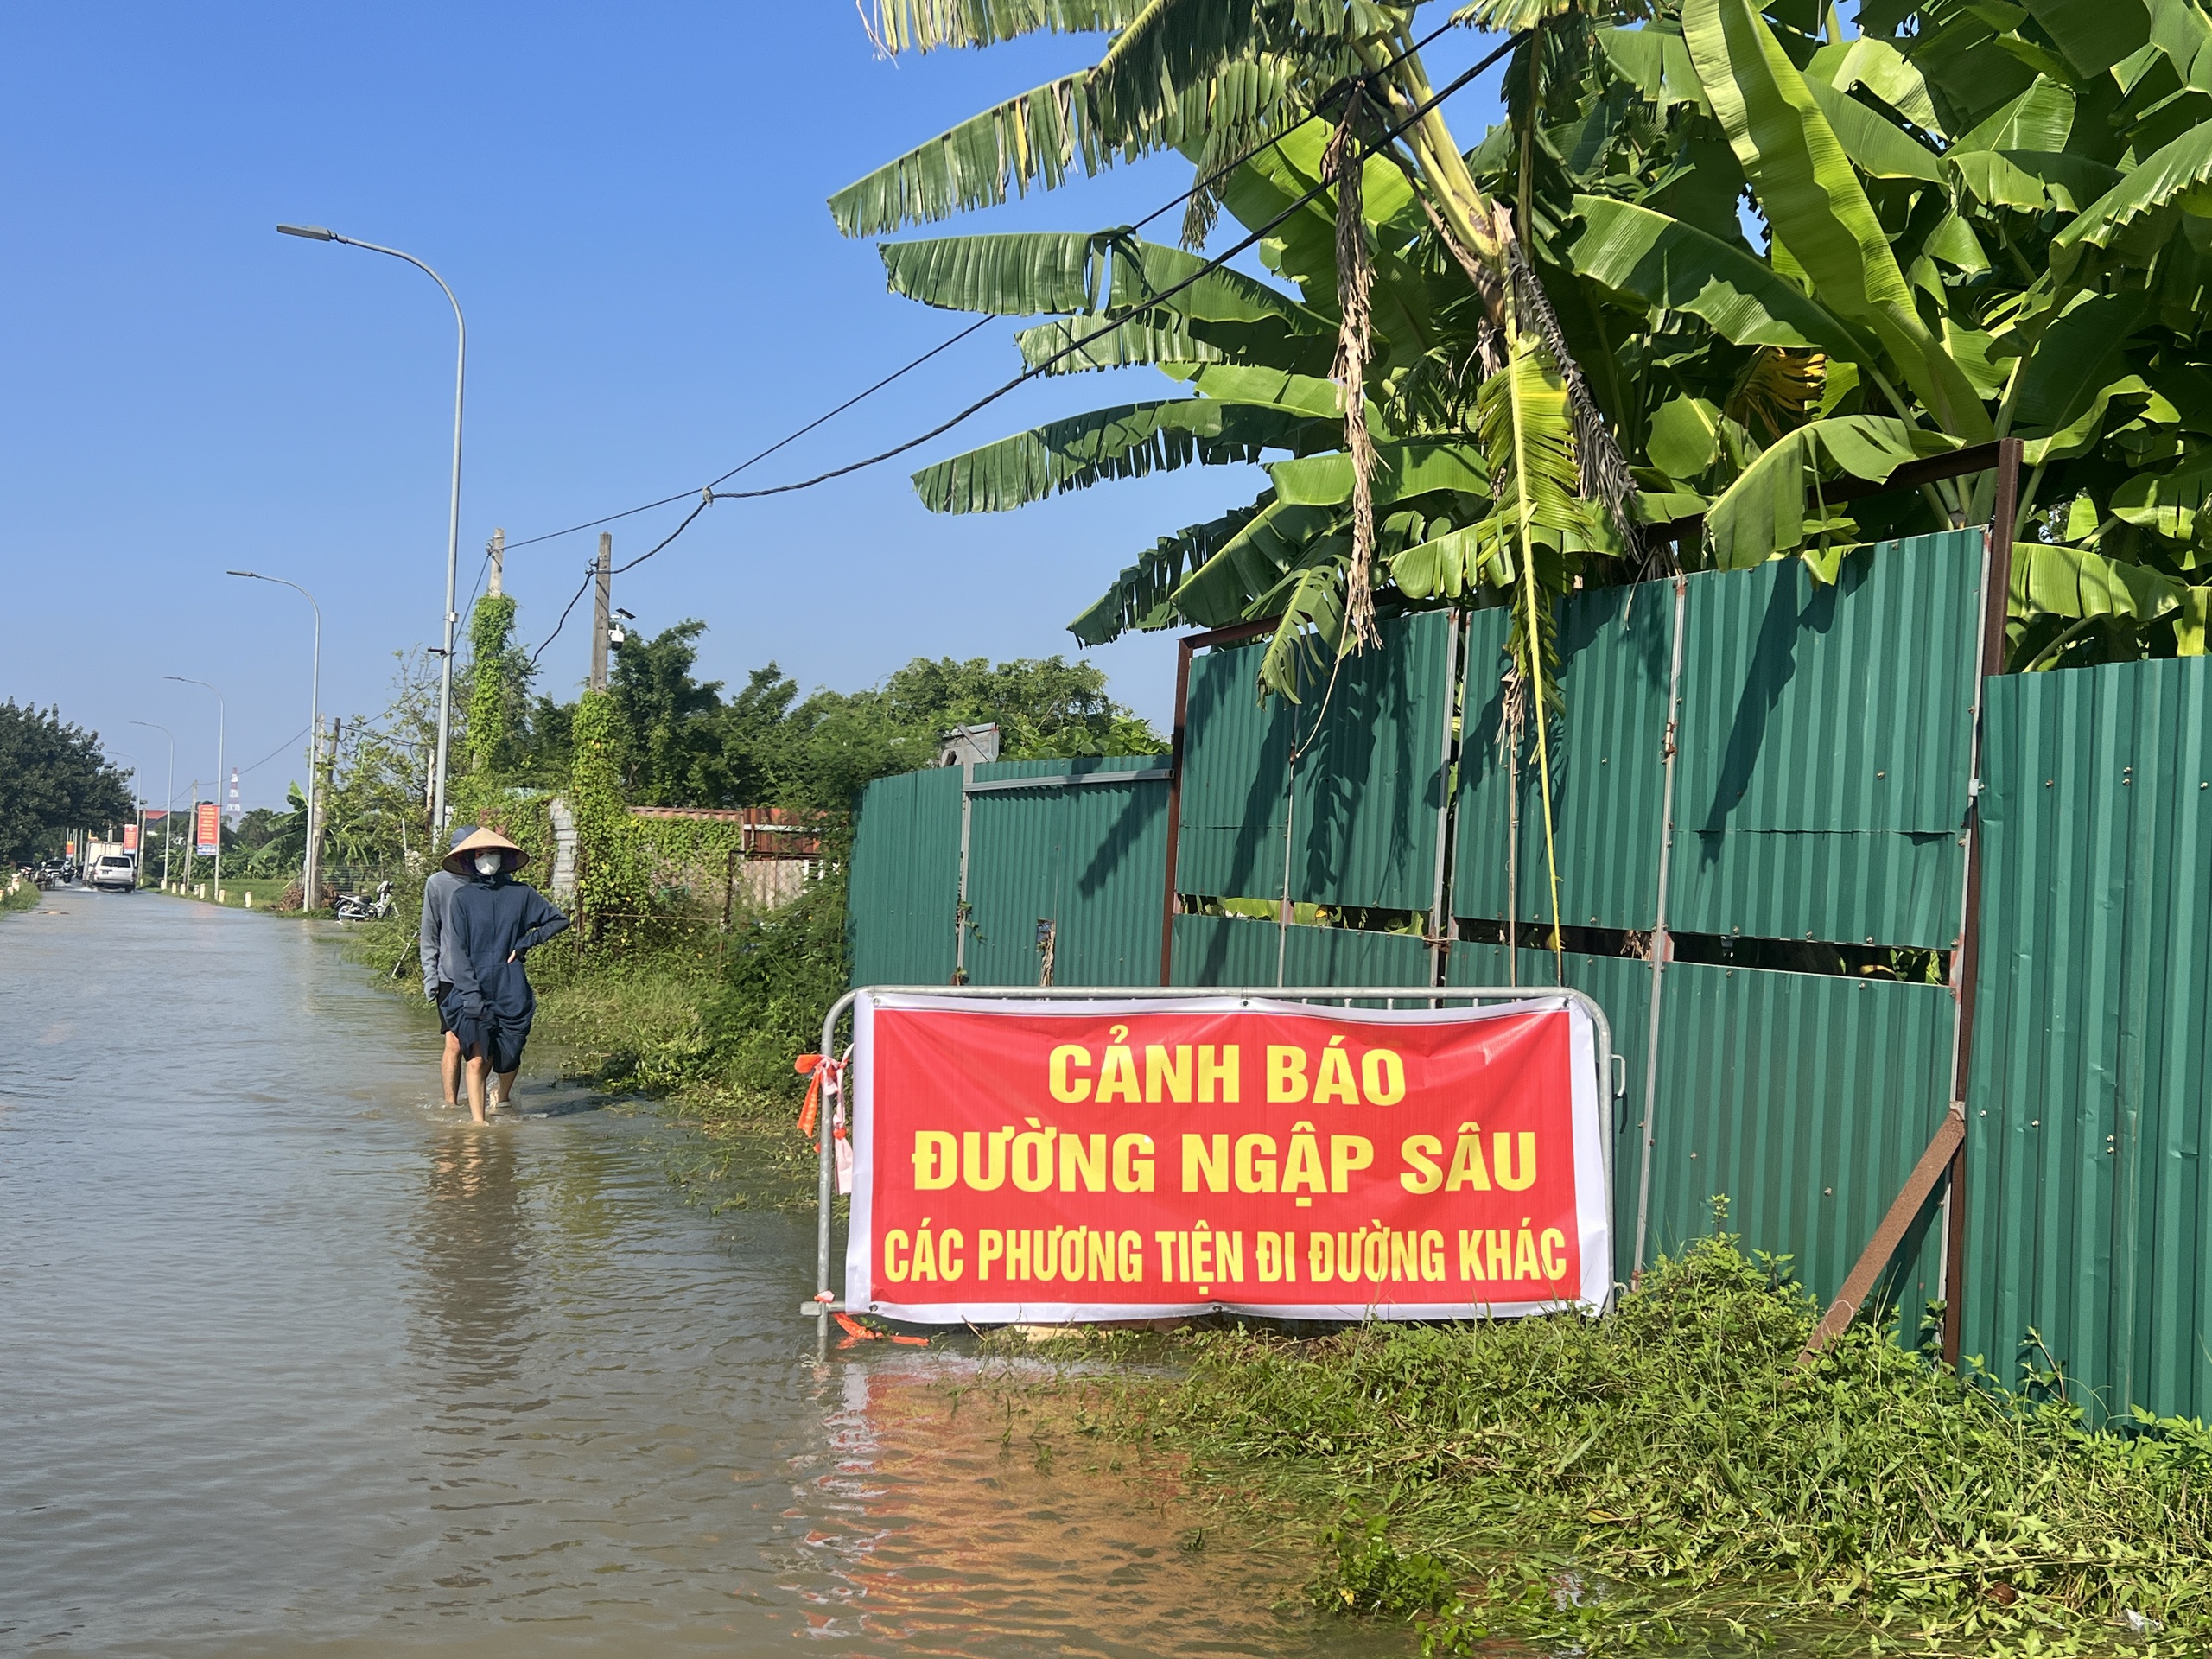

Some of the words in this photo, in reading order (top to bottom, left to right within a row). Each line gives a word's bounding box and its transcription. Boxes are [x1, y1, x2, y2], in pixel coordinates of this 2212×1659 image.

[1048, 1024, 1240, 1103] CẢNH
[1266, 1034, 1406, 1107] BÁO
[911, 1116, 1155, 1193] ĐƯỜNG
[1181, 1121, 1374, 1207] NGẬP
[1400, 1122, 1537, 1195] SÂU
[884, 1217, 964, 1283] CÁC
[978, 1224, 1143, 1283] PHƯƠNG
[1154, 1219, 1244, 1295] TIỆN
[1255, 1230, 1296, 1283] ĐI
[1307, 1218, 1446, 1283] ĐƯỜNG
[1458, 1217, 1567, 1281] KHÁC
